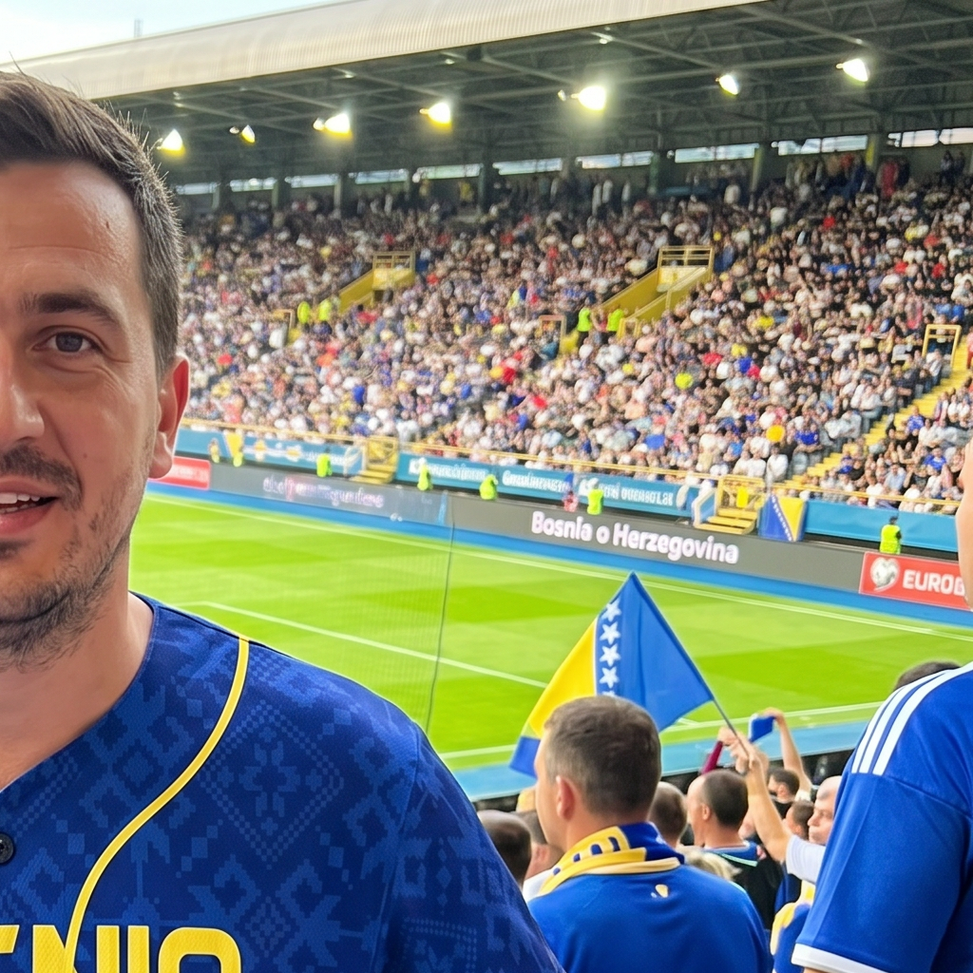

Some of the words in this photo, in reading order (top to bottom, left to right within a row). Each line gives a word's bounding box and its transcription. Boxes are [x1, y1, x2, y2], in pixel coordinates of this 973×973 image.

[531, 511, 593, 542] Bosnia
[596, 525, 611, 544] o
[612, 522, 739, 564] Herzegovina
